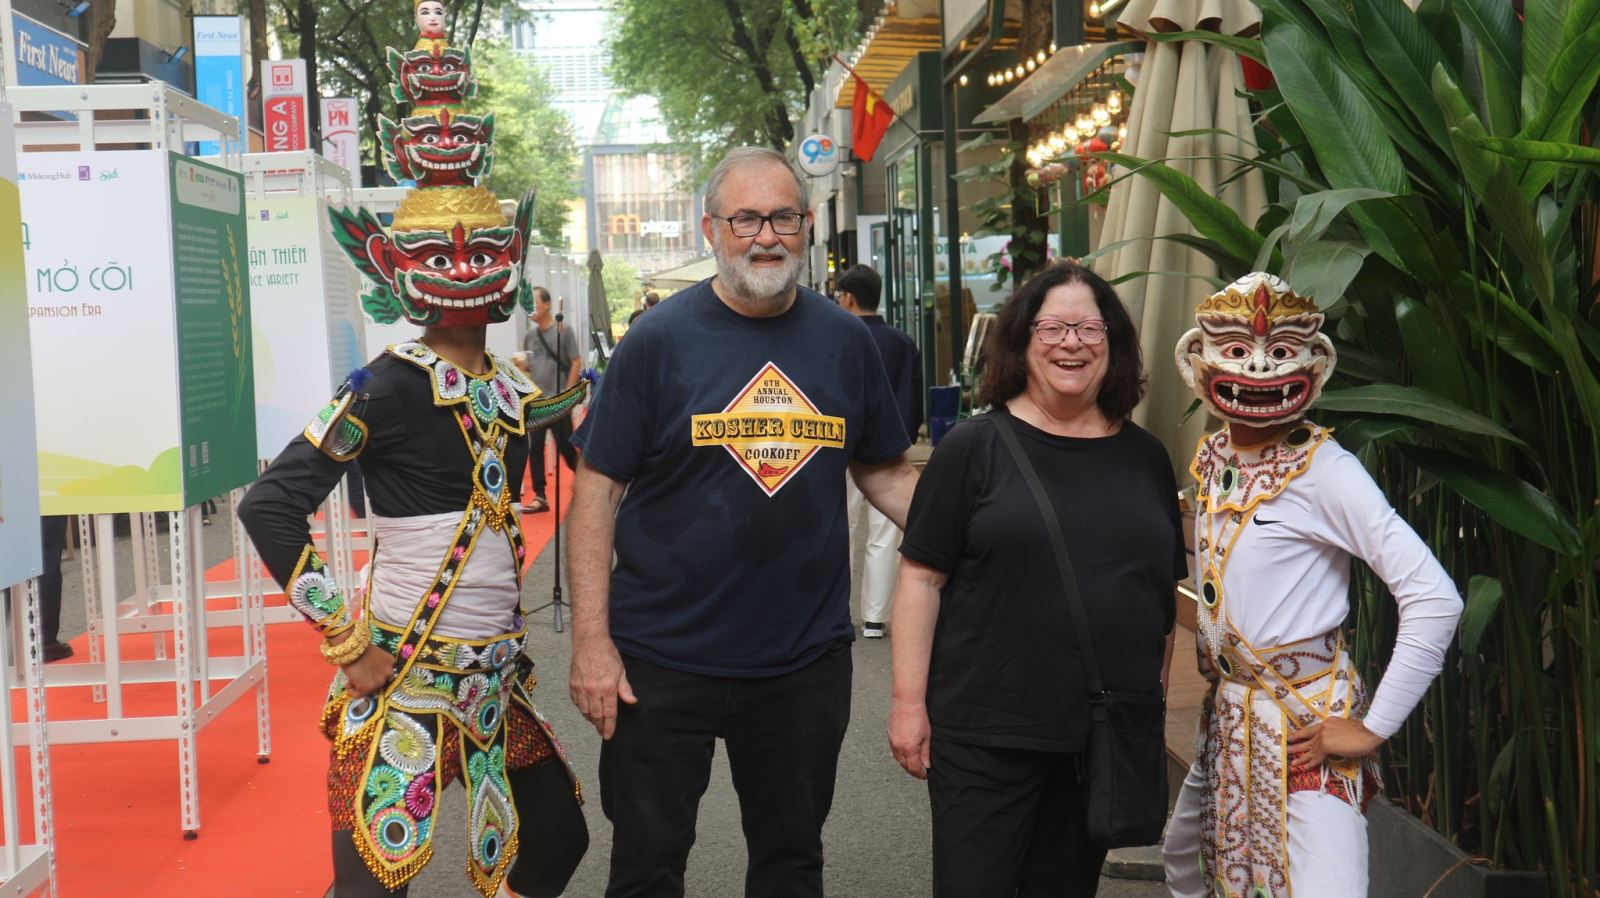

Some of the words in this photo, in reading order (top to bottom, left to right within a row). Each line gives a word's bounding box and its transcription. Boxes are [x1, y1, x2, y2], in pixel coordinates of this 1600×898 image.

[196, 31, 215, 40] First
[217, 31, 238, 40] News
[18, 30, 46, 71] First
[48, 43, 77, 84] News
[271, 101, 288, 116] A
[290, 102, 299, 131] COMPANY
[328, 111, 349, 127] PN
[272, 120, 289, 150] NG
[27, 171, 72, 182] MekongHub
[249, 246, 266, 270] ẬN
[37, 258, 79, 293] MỞ
[89, 261, 133, 291] CÕI
[250, 275, 263, 287] ICE
[266, 273, 299, 286] VARIETY
[29, 306, 78, 318] PANSION
[82, 303, 102, 317] ERA
[757, 388, 789, 396] ANNUAL
[753, 396, 793, 404] HOUSTON
[695, 416, 785, 440] KOSHER
[791, 416, 844, 443] CHILI
[745, 448, 801, 461] COOKOFF
